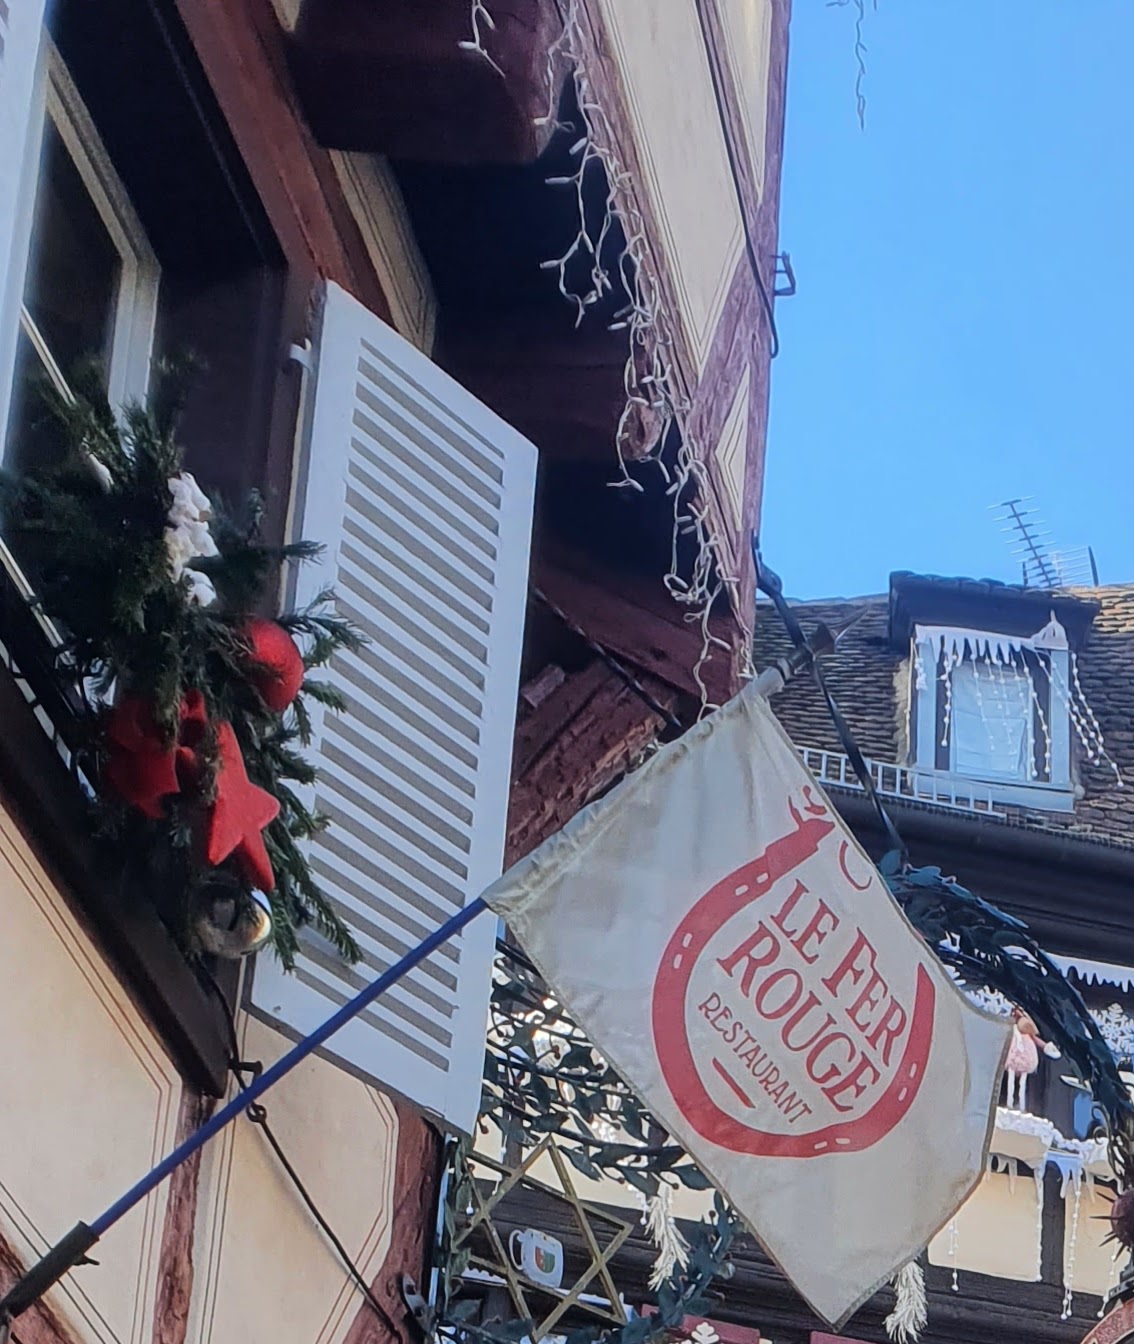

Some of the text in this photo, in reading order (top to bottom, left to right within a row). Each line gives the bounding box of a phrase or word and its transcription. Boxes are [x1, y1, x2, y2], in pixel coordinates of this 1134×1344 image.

[697, 992, 814, 1123] RESTAURANT
[716, 921, 880, 1113] ROUGE
[770, 877, 908, 1068] LE FER
